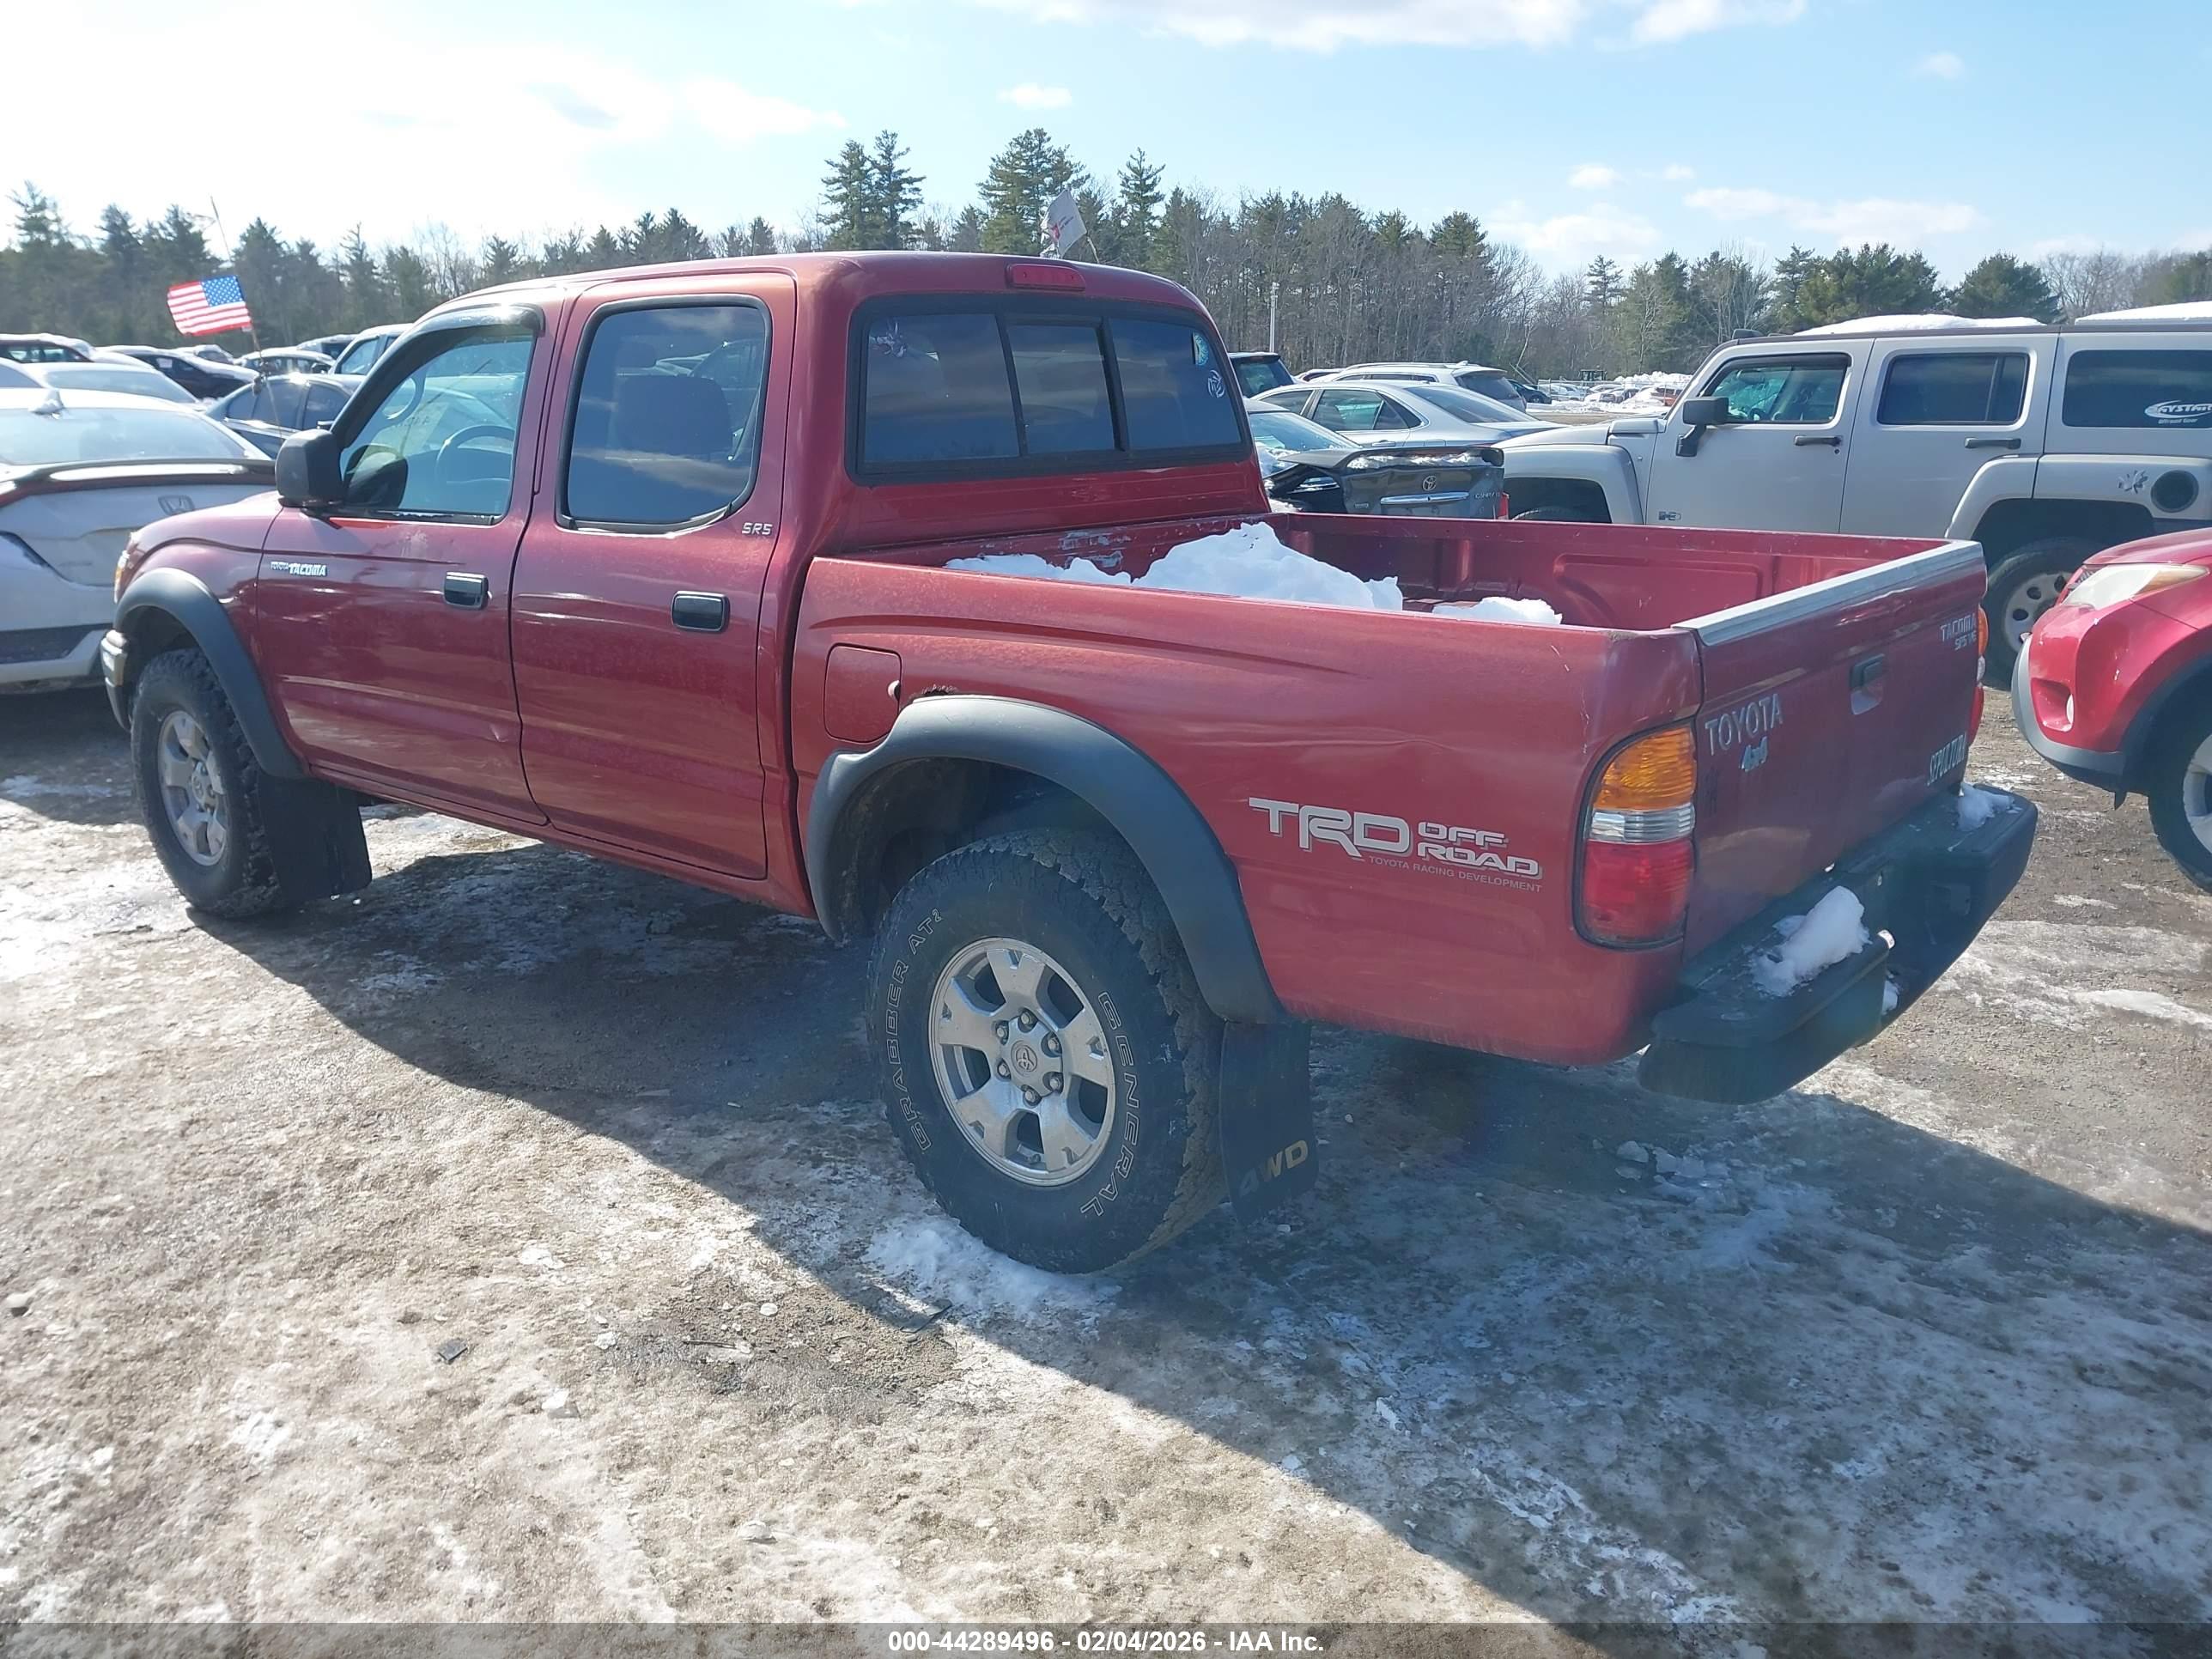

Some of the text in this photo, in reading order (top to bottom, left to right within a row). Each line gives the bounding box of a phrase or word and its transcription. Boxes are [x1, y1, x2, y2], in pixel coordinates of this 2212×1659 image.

[742, 521, 773, 535] SR5
[270, 561, 326, 576] TOYOTA TACOMA
[1940, 612, 1977, 642] TACOMA
[1705, 693, 1784, 757] TOYOTA
[1249, 797, 1507, 861] TRD OFF
[1369, 856, 1542, 893] TOYOTA RACING DEVELOPMENT
[1418, 842, 1542, 878] ROAD
[885, 960, 933, 1151] GRABBER
[1080, 991, 1140, 1217] GENERAL
